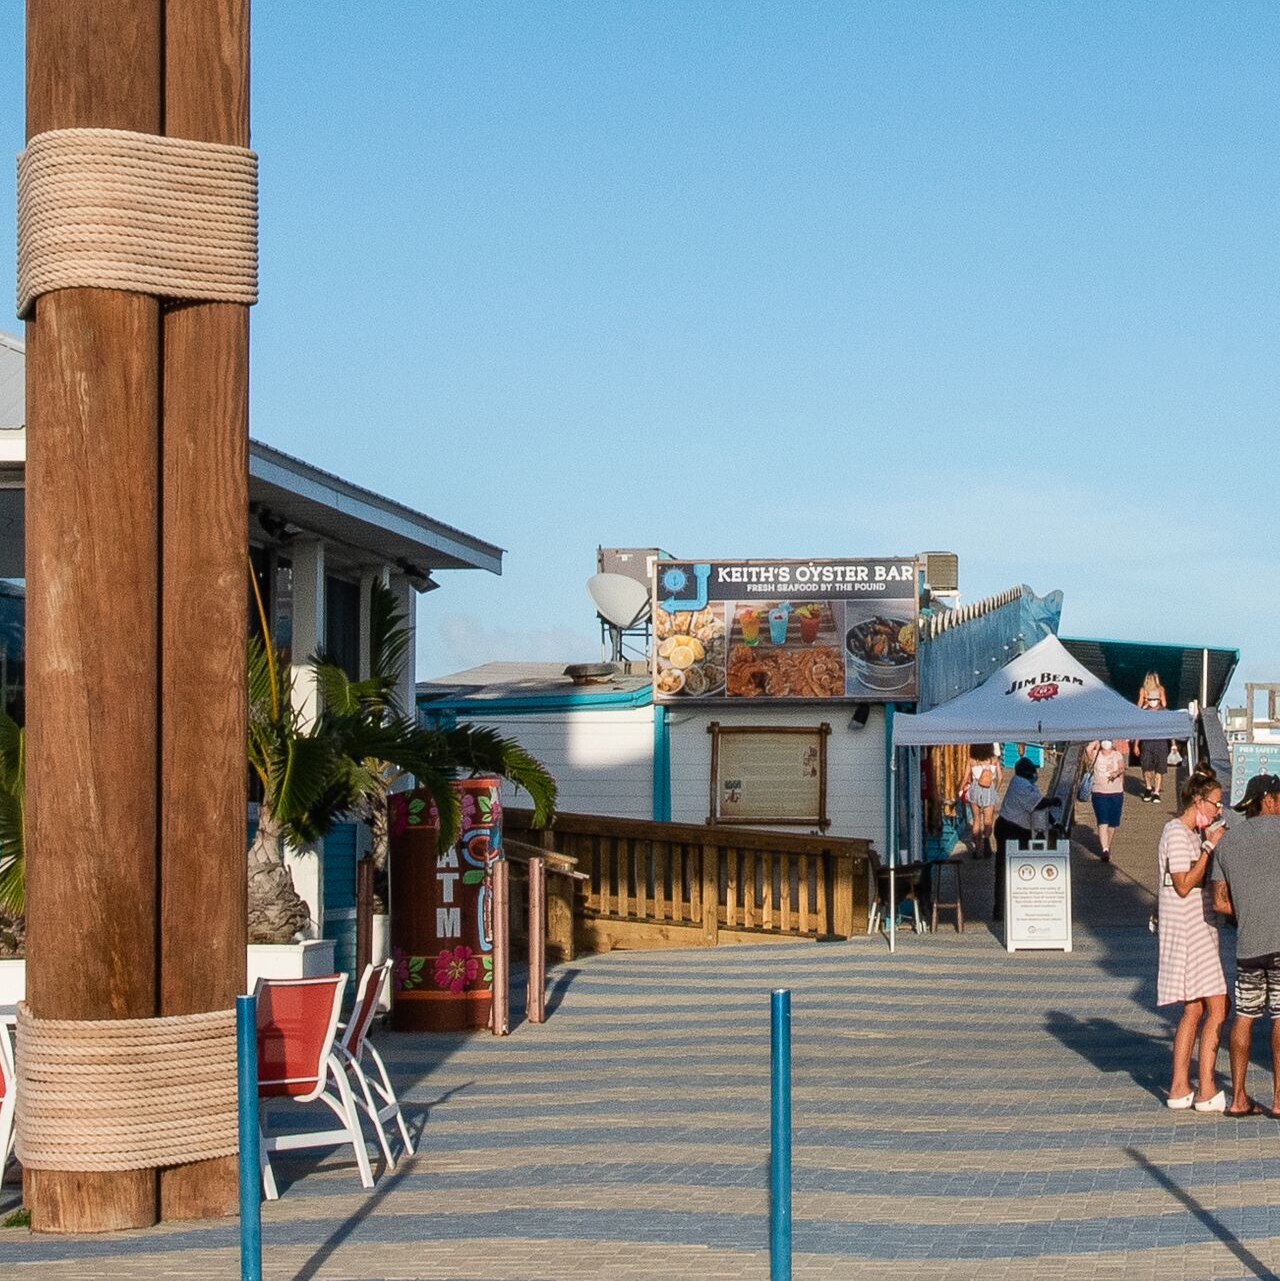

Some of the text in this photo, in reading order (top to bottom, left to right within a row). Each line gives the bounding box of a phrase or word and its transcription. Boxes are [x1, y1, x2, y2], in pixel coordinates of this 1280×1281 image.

[718, 566, 913, 583] KEITH'S OYSTER BAR
[747, 583, 886, 592] FRESH SEAFOOD BY THE POUND
[1005, 672, 1083, 695] JIM BEAM
[436, 844, 461, 938] ATM
